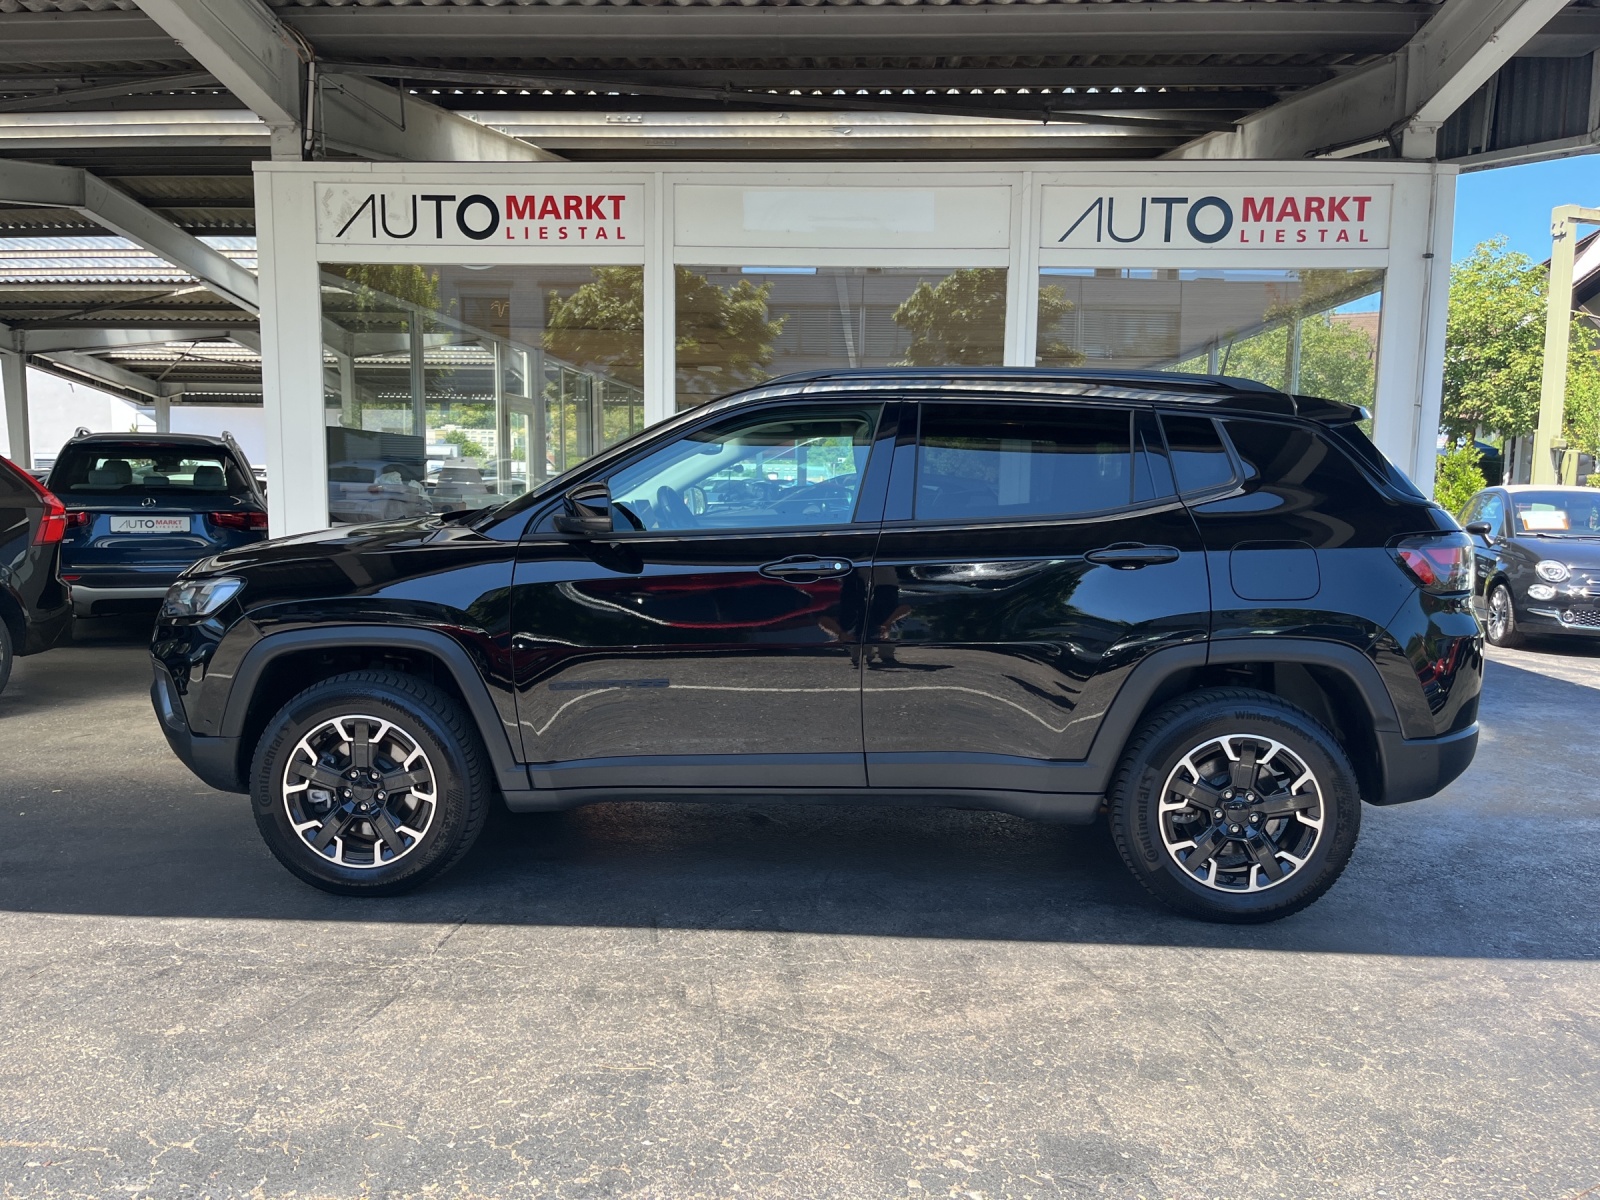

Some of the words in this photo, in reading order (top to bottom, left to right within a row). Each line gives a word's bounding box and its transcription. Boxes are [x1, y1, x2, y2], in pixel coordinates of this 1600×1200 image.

[335, 193, 500, 240] AUTO
[505, 195, 626, 220] MARKT
[506, 227, 626, 240] LIESTAL
[1057, 196, 1234, 244] AUTO
[1240, 196, 1372, 222] MARKT
[1239, 229, 1369, 243] LIESTAL
[119, 519, 155, 529] AUTO
[257, 735, 284, 808] Continental
[1135, 785, 1160, 863] Continental
